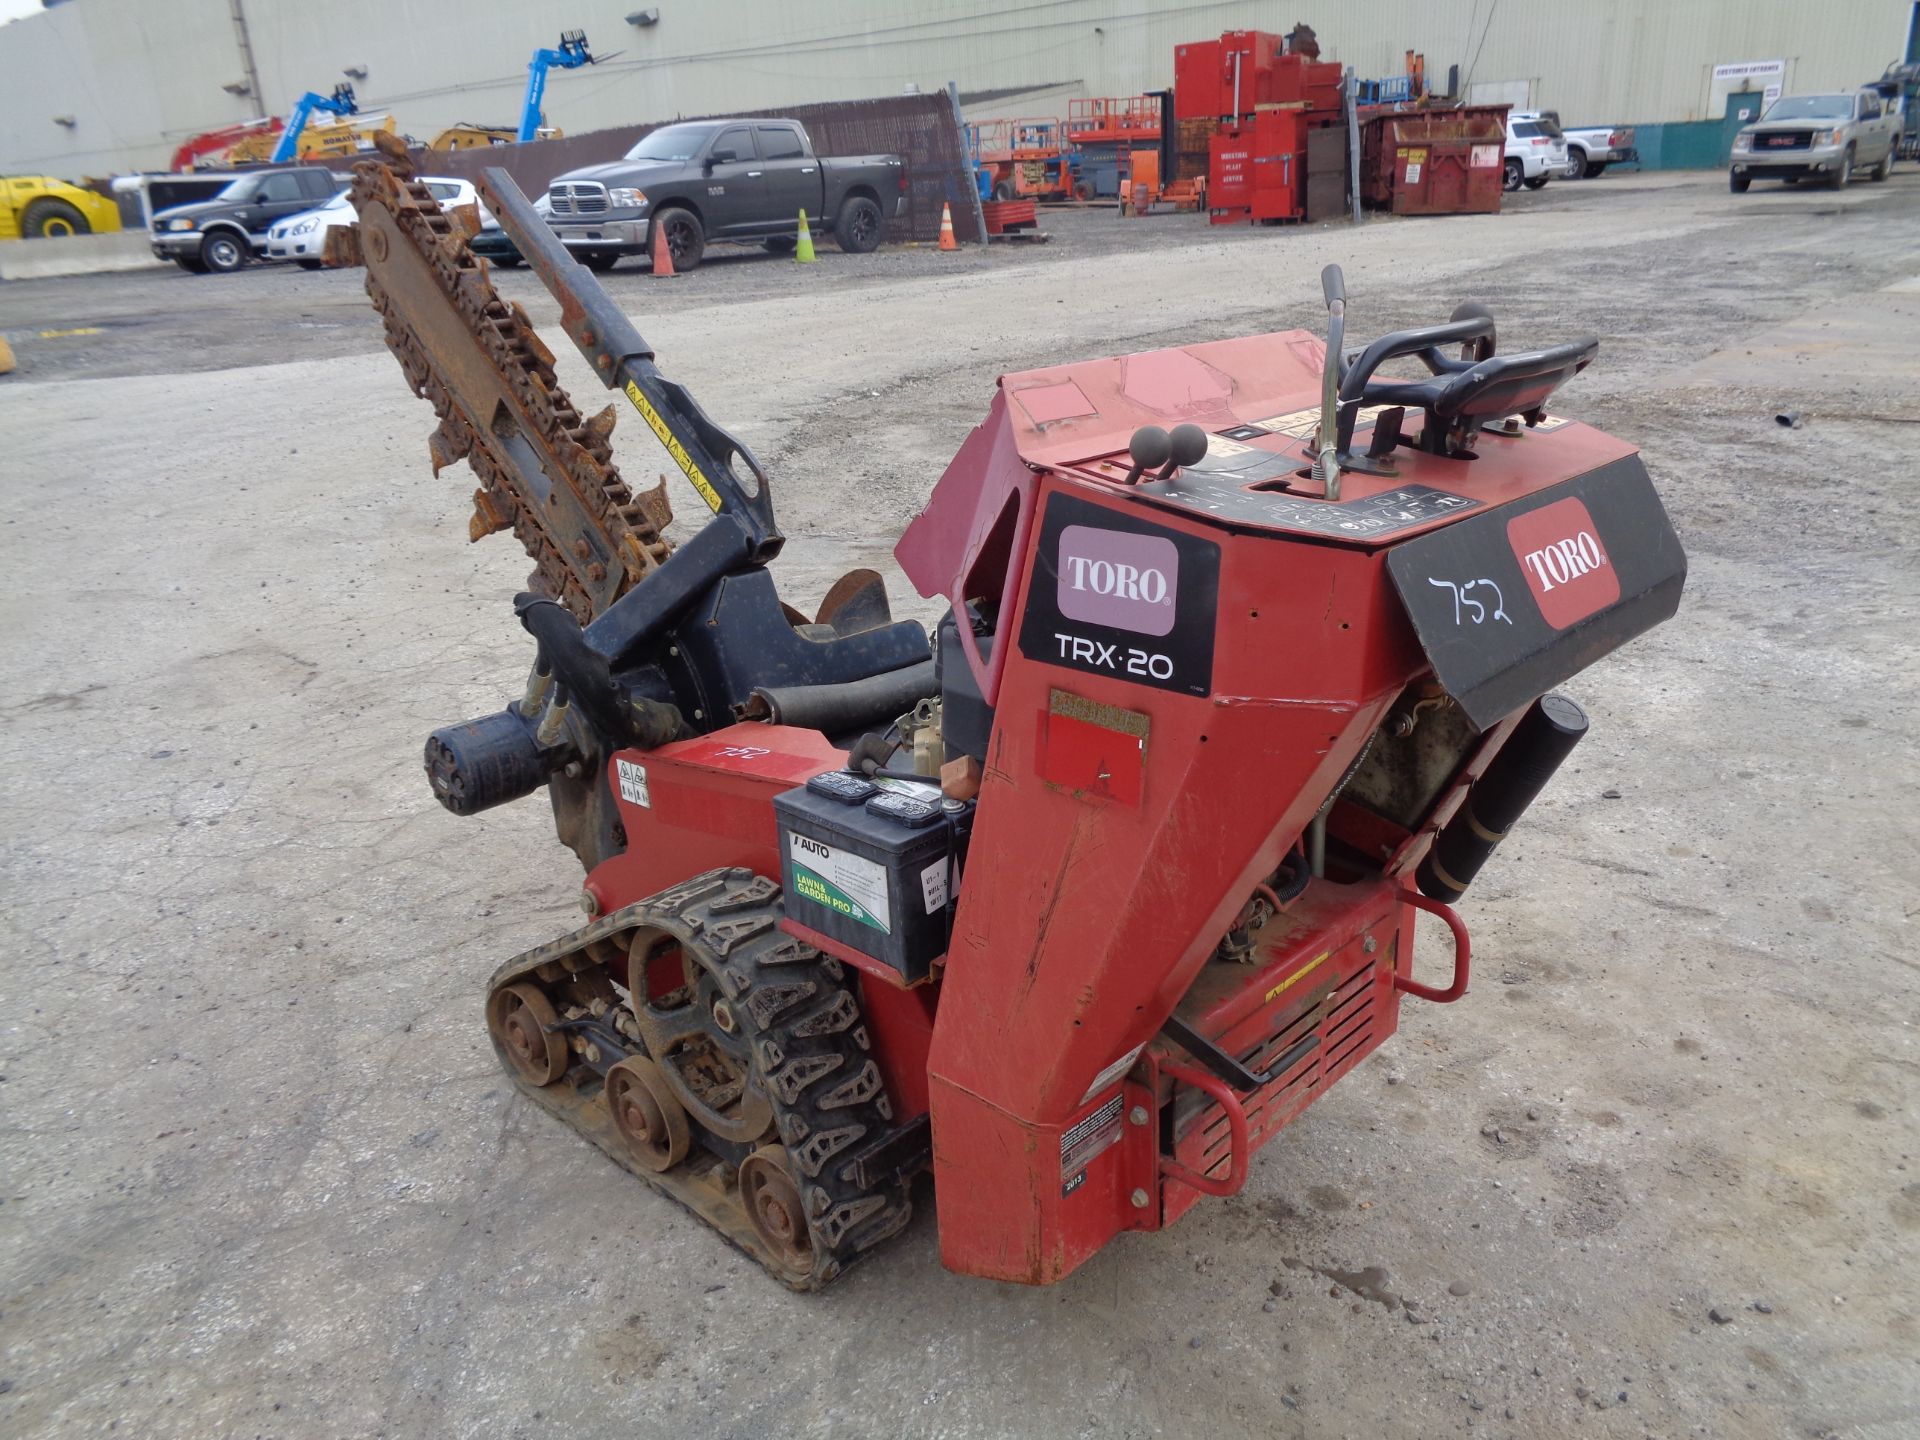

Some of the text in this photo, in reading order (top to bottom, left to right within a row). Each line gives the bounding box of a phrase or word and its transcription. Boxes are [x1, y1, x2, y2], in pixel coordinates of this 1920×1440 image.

[1067, 555, 1167, 603] TORO
[1525, 531, 1600, 592] TORO
[1428, 577, 1513, 625] 752
[801, 839, 829, 859] AUTO
[797, 883, 851, 913] GARDEN PRO
[1066, 1174, 1082, 1191] 2013
